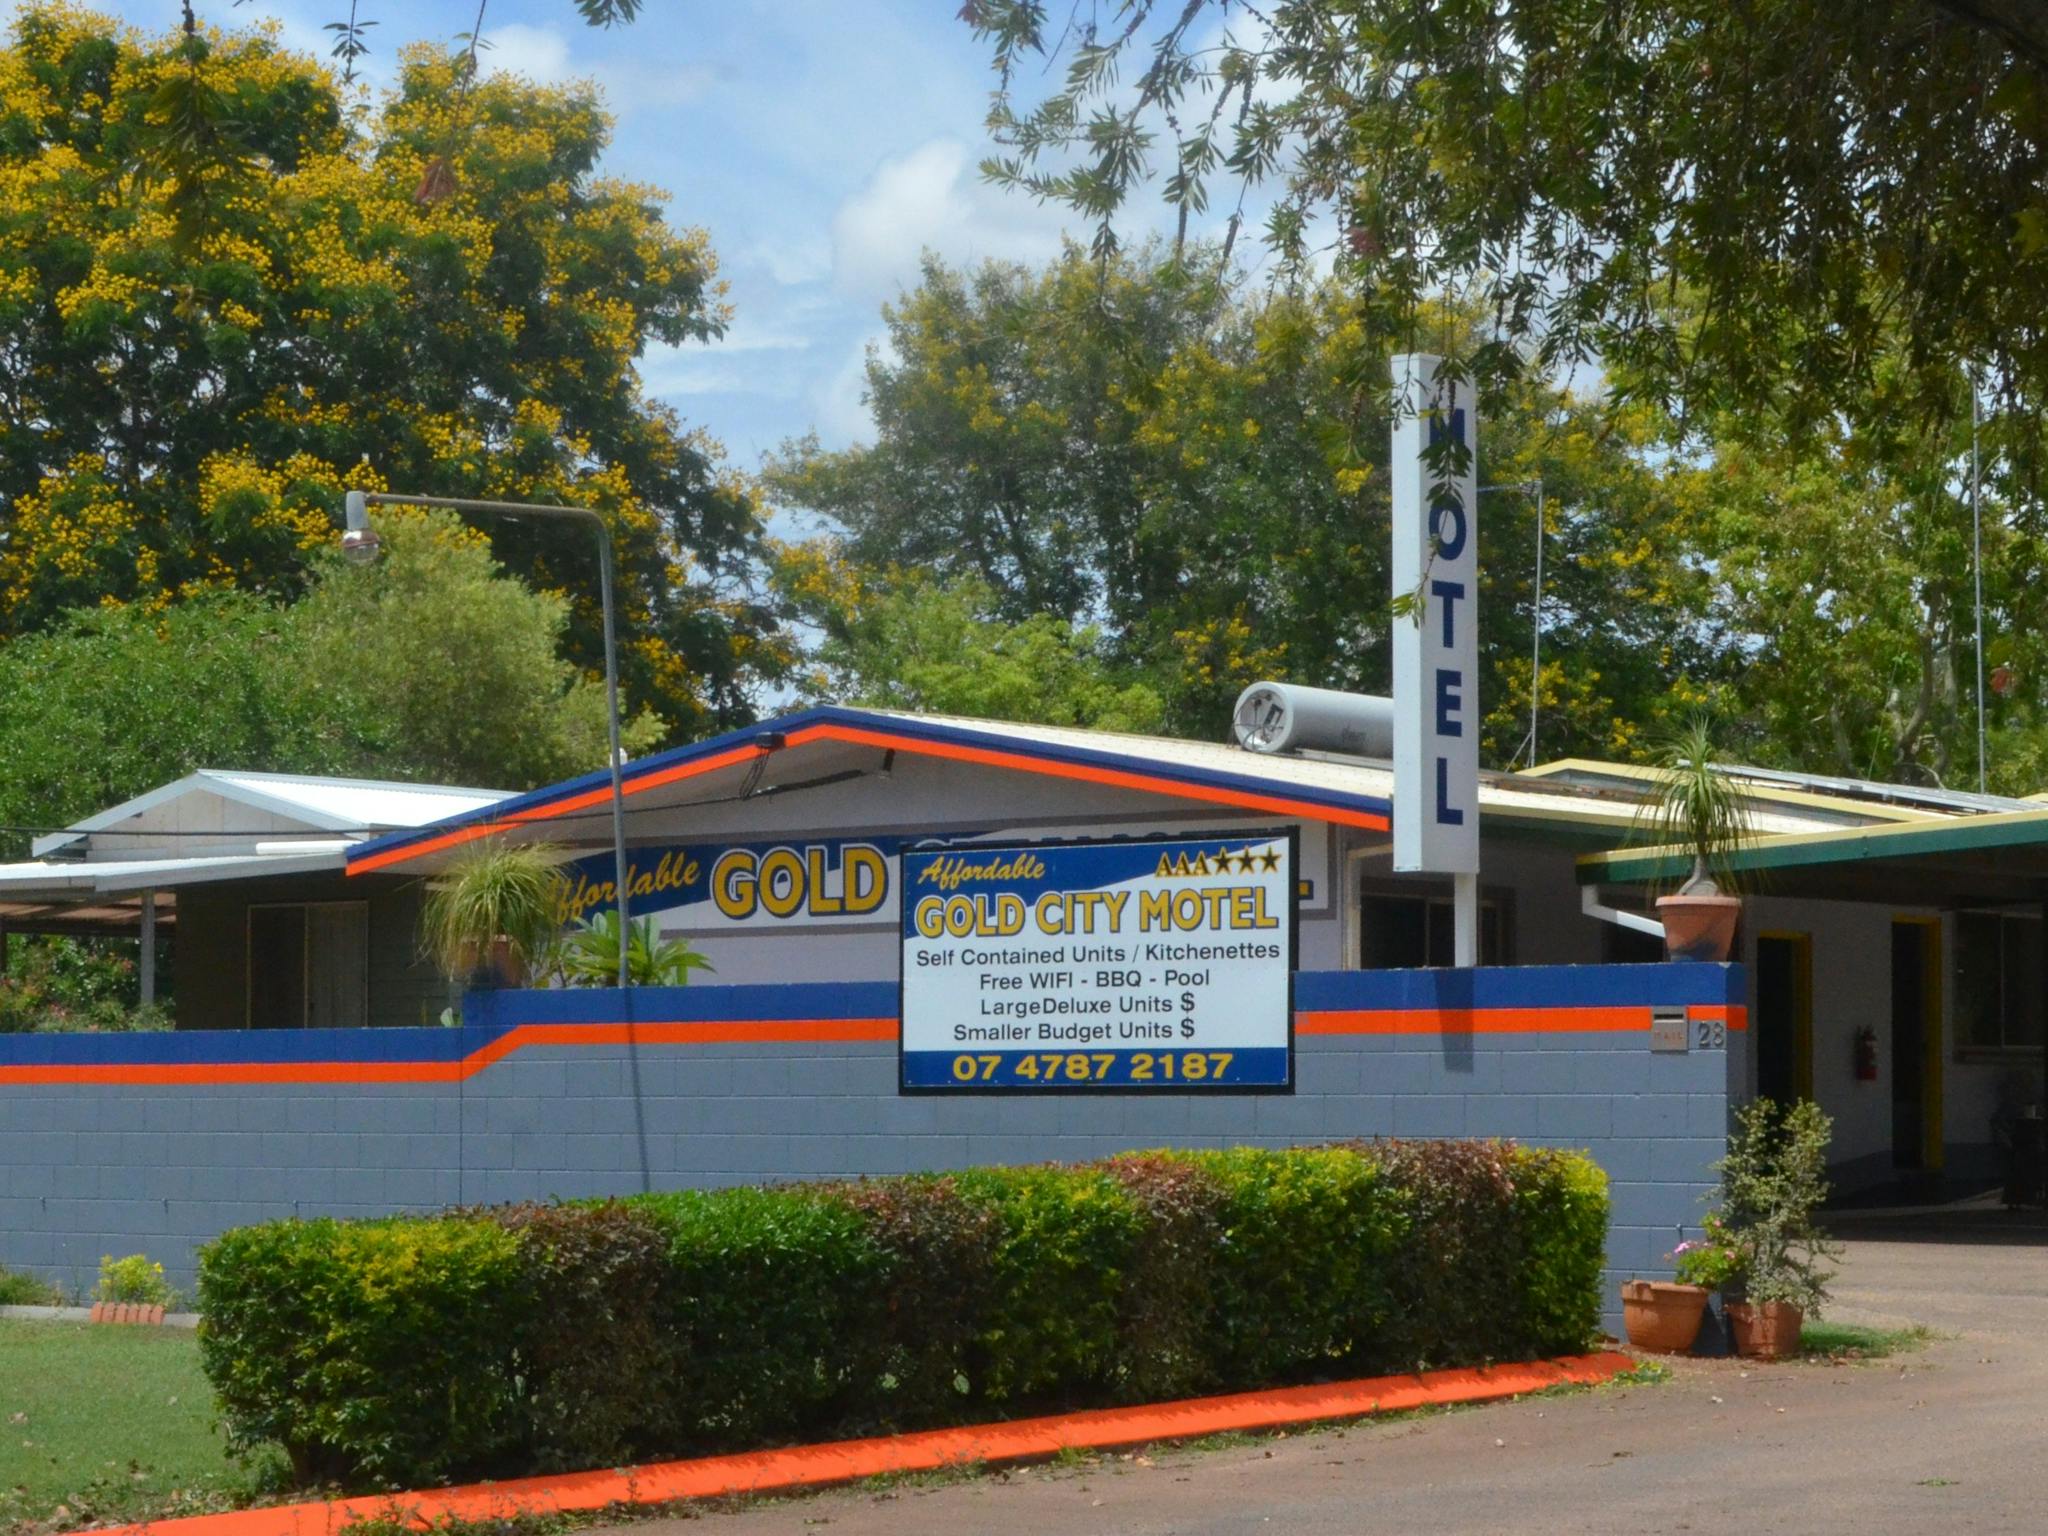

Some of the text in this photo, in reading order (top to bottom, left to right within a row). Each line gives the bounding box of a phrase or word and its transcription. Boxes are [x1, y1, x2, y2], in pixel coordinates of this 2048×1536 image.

[918, 852, 1046, 890] Affordable
[1155, 850, 1210, 878] AAA
[712, 845, 887, 919] GOLD
[915, 886, 1279, 938] GOLD CITY MOTEL
[916, 949, 954, 967] Self
[961, 946, 1065, 965] Contained
[1072, 945, 1126, 963] Units
[1145, 942, 1280, 960] Kitchenettes
[980, 973, 1023, 990] Free
[1030, 971, 1073, 989] WIFI
[1096, 970, 1142, 988] BBQ
[1164, 969, 1210, 986] Pool
[1119, 996, 1173, 1013] Units
[1181, 991, 1196, 1014] $
[953, 1017, 1196, 1043] Smaller Budget Units $
[952, 1052, 1234, 1081] 07 4787 2187
